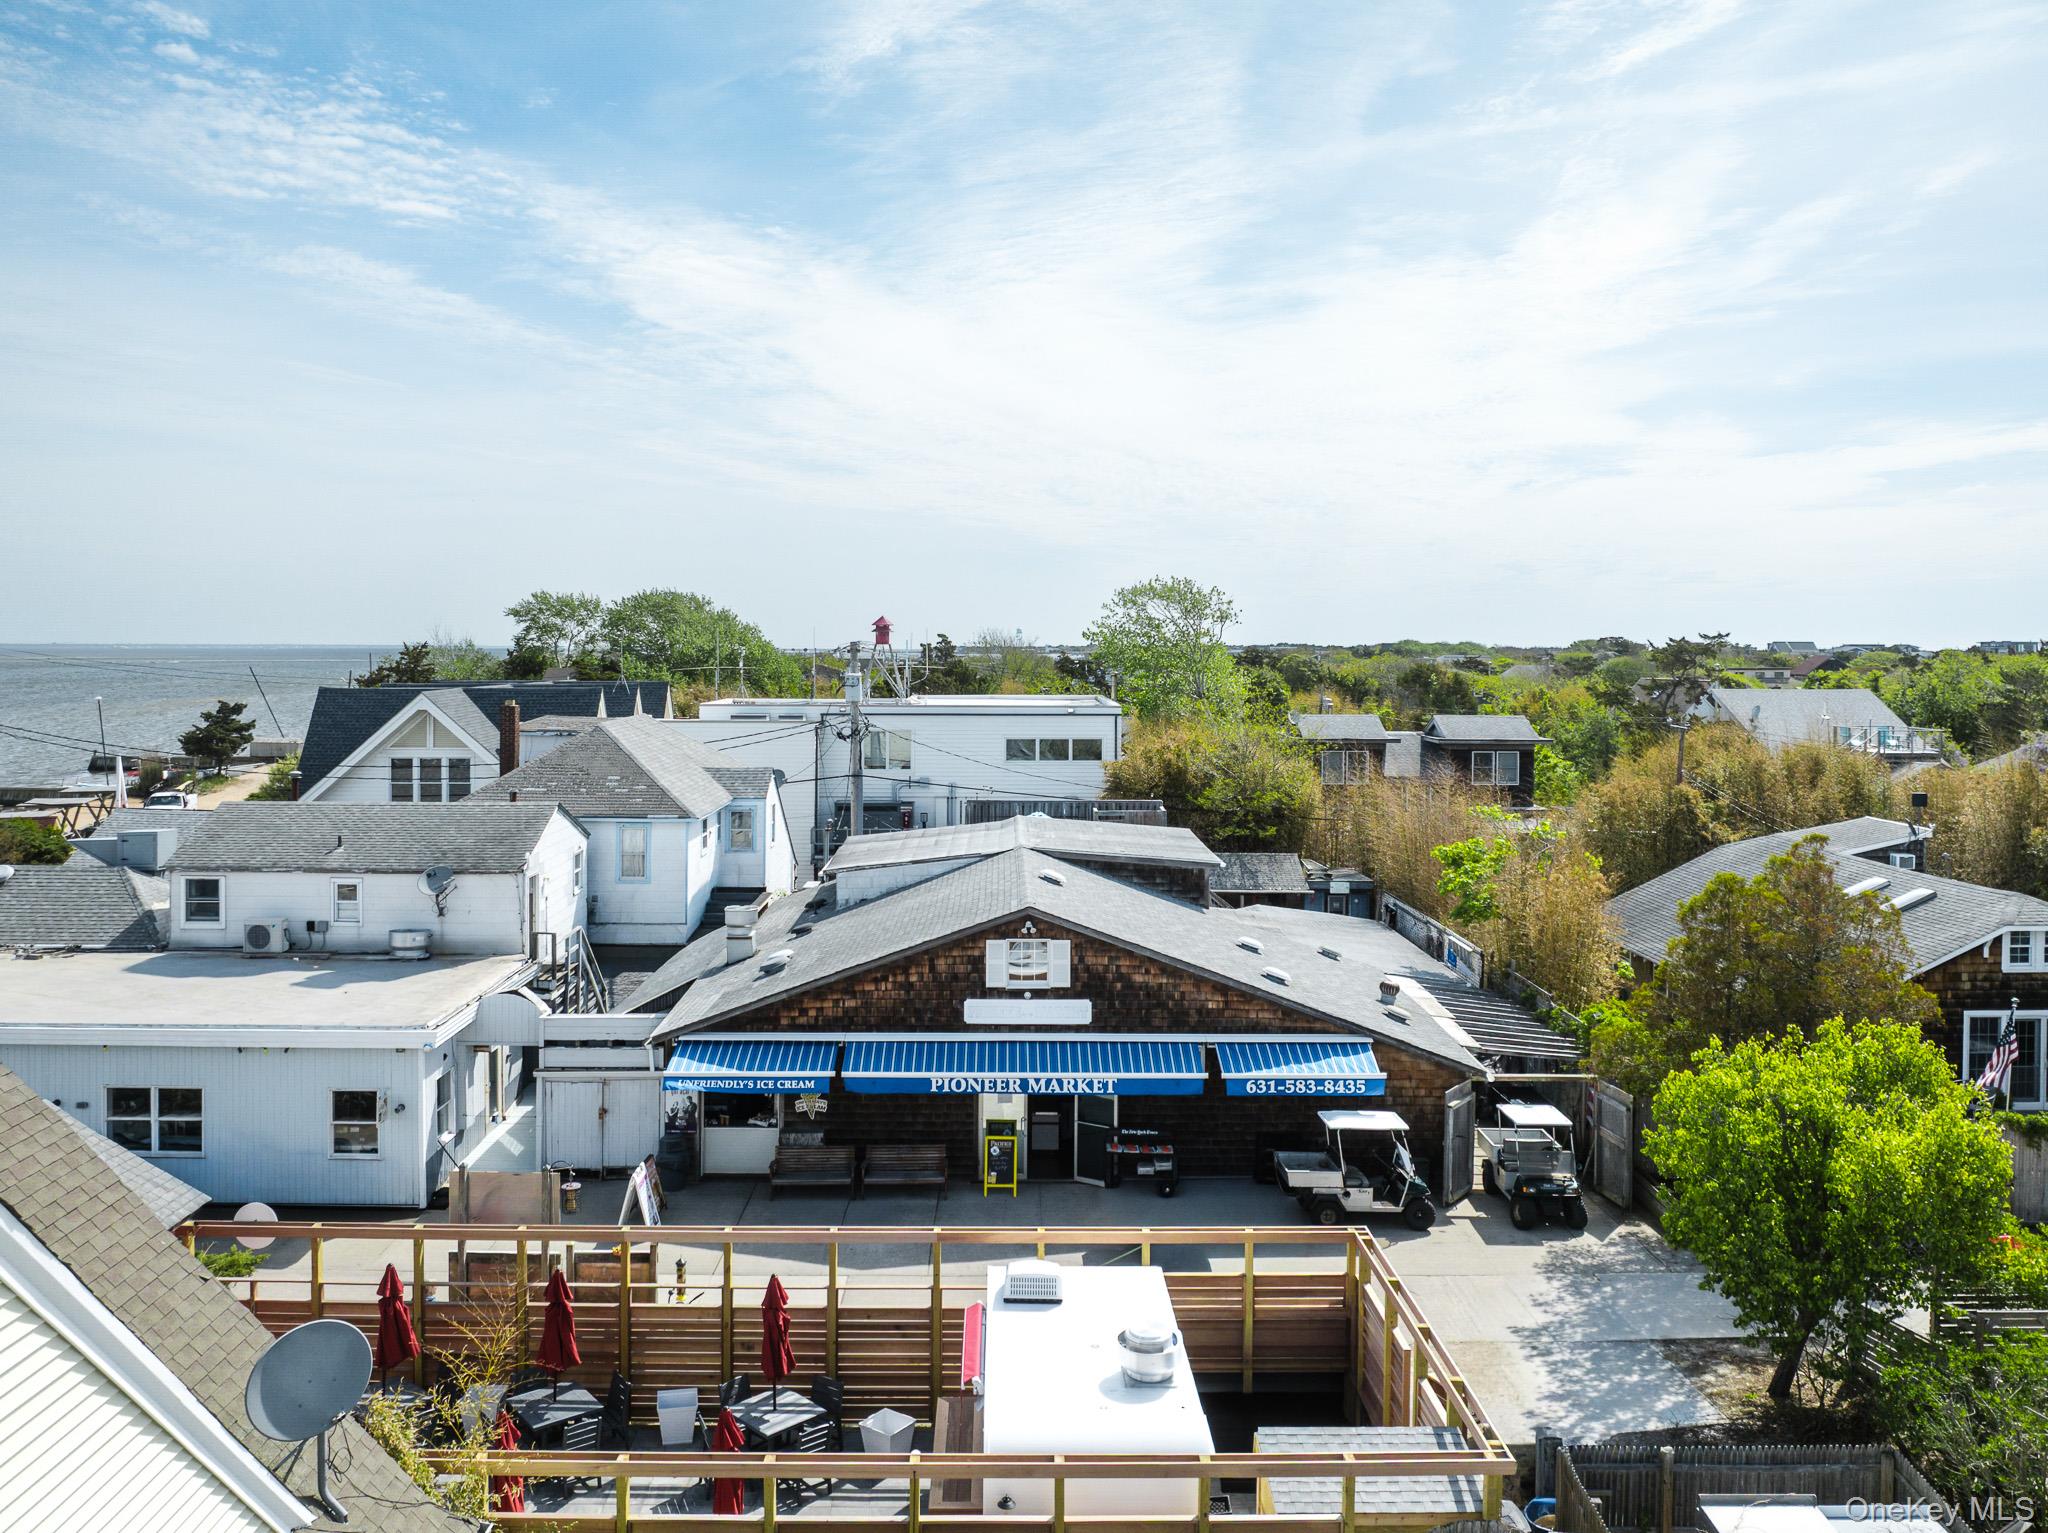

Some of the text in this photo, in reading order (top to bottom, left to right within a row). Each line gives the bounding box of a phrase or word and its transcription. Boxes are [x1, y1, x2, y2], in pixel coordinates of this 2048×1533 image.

[677, 1079, 815, 1089] UNFRIENDLY'S ICE CREAM
[930, 1077, 1117, 1094] PIONEER MARKET
[1246, 1079, 1366, 1094] 631-583-8435
